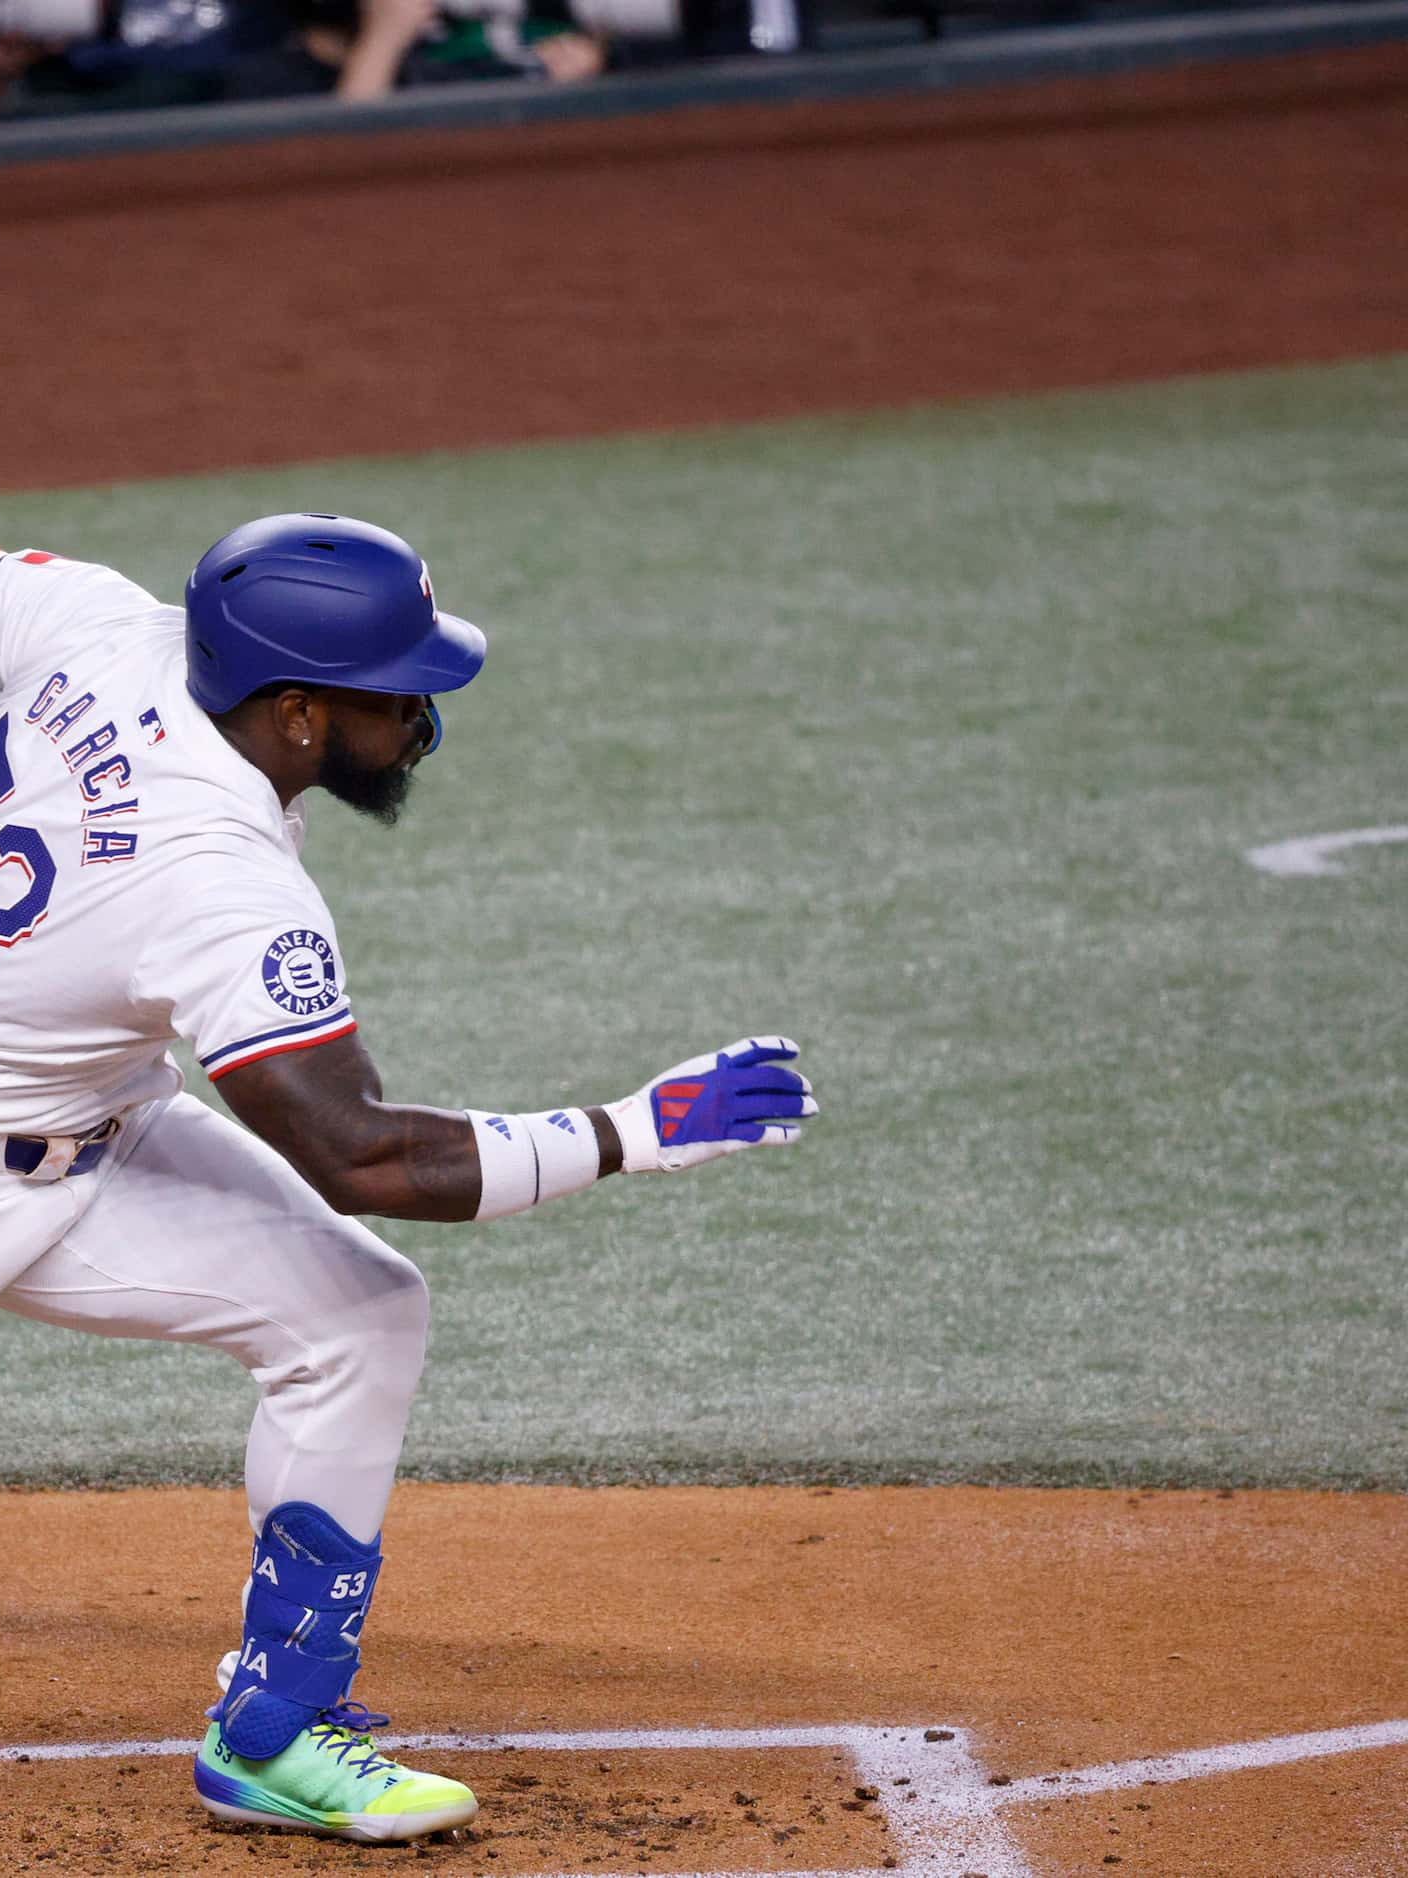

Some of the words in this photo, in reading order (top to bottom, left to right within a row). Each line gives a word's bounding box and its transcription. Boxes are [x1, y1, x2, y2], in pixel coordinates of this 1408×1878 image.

[267, 931, 334, 963] ENERGY
[265, 975, 339, 1015] TRANSFER
[330, 1571, 368, 1600] 53
